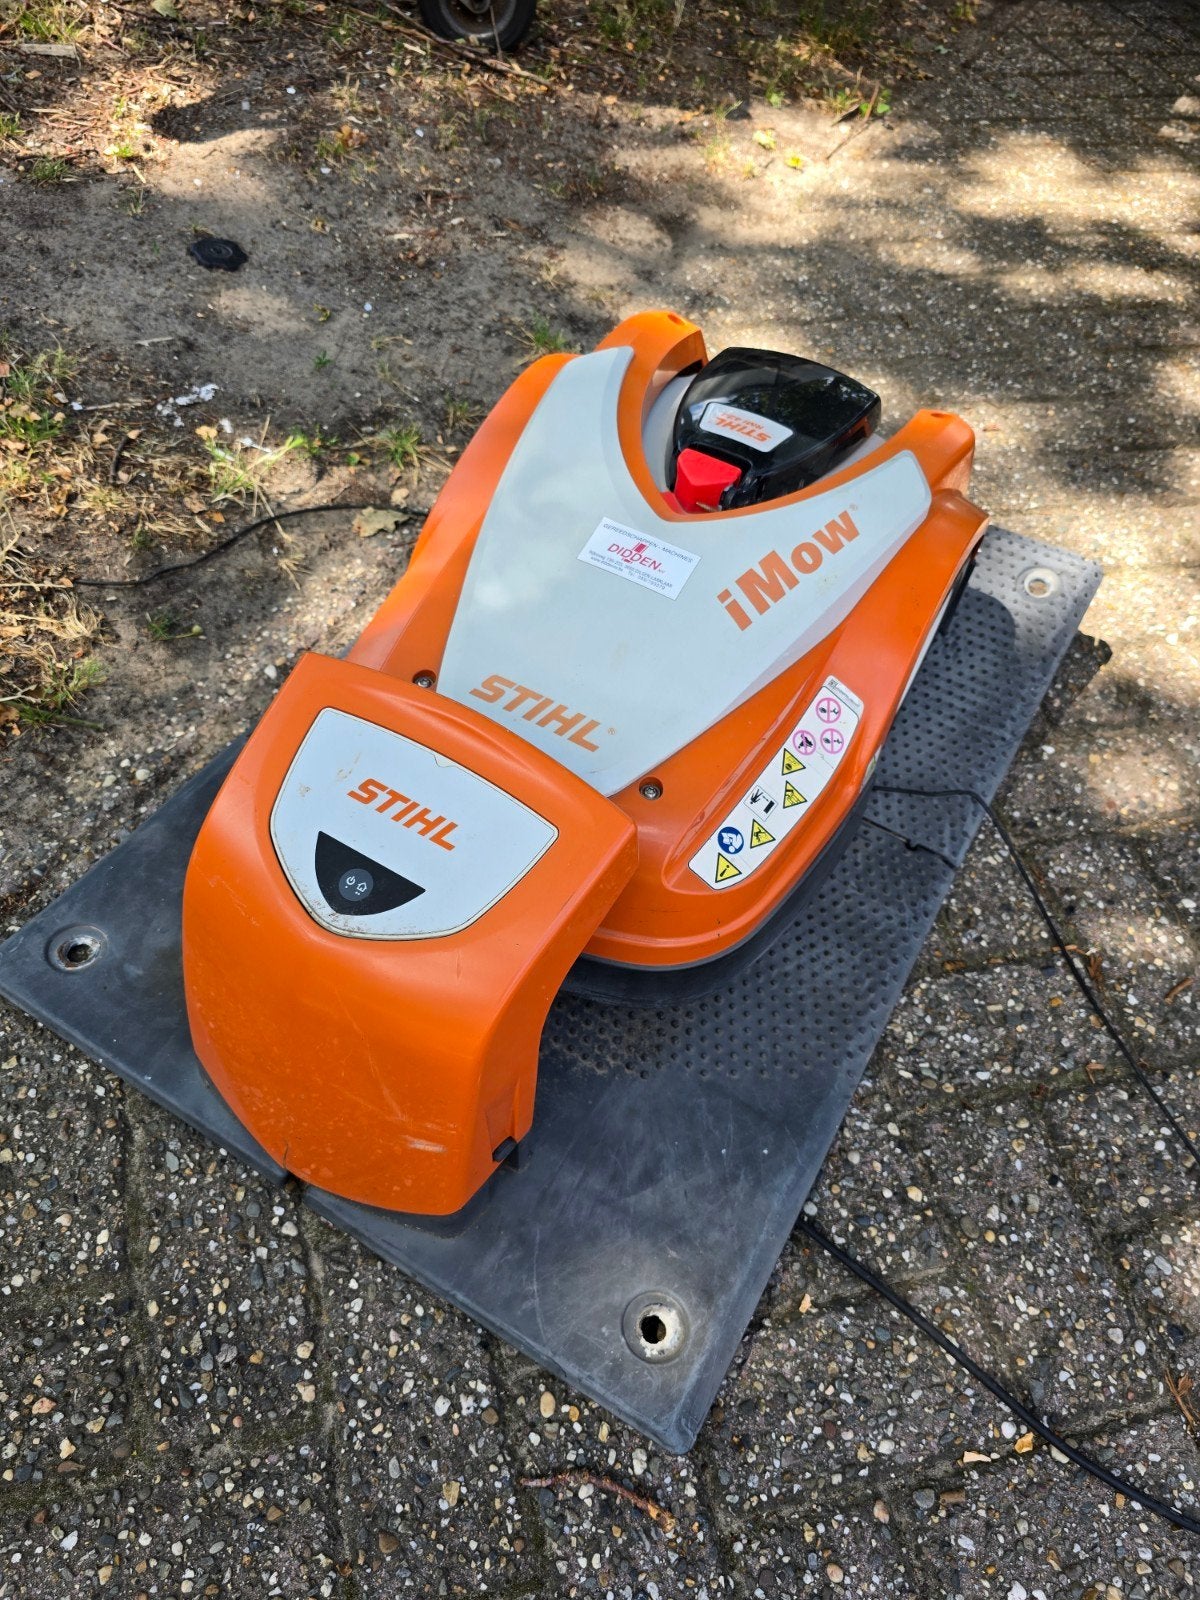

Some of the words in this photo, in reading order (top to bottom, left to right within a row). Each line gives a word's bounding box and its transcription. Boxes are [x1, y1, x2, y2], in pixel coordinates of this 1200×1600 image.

[716, 416, 772, 442] STIHL
[607, 543, 662, 571] DIDDEN
[717, 510, 860, 631] iMow
[468, 674, 601, 753] STIHL
[346, 778, 459, 851] STIHL
